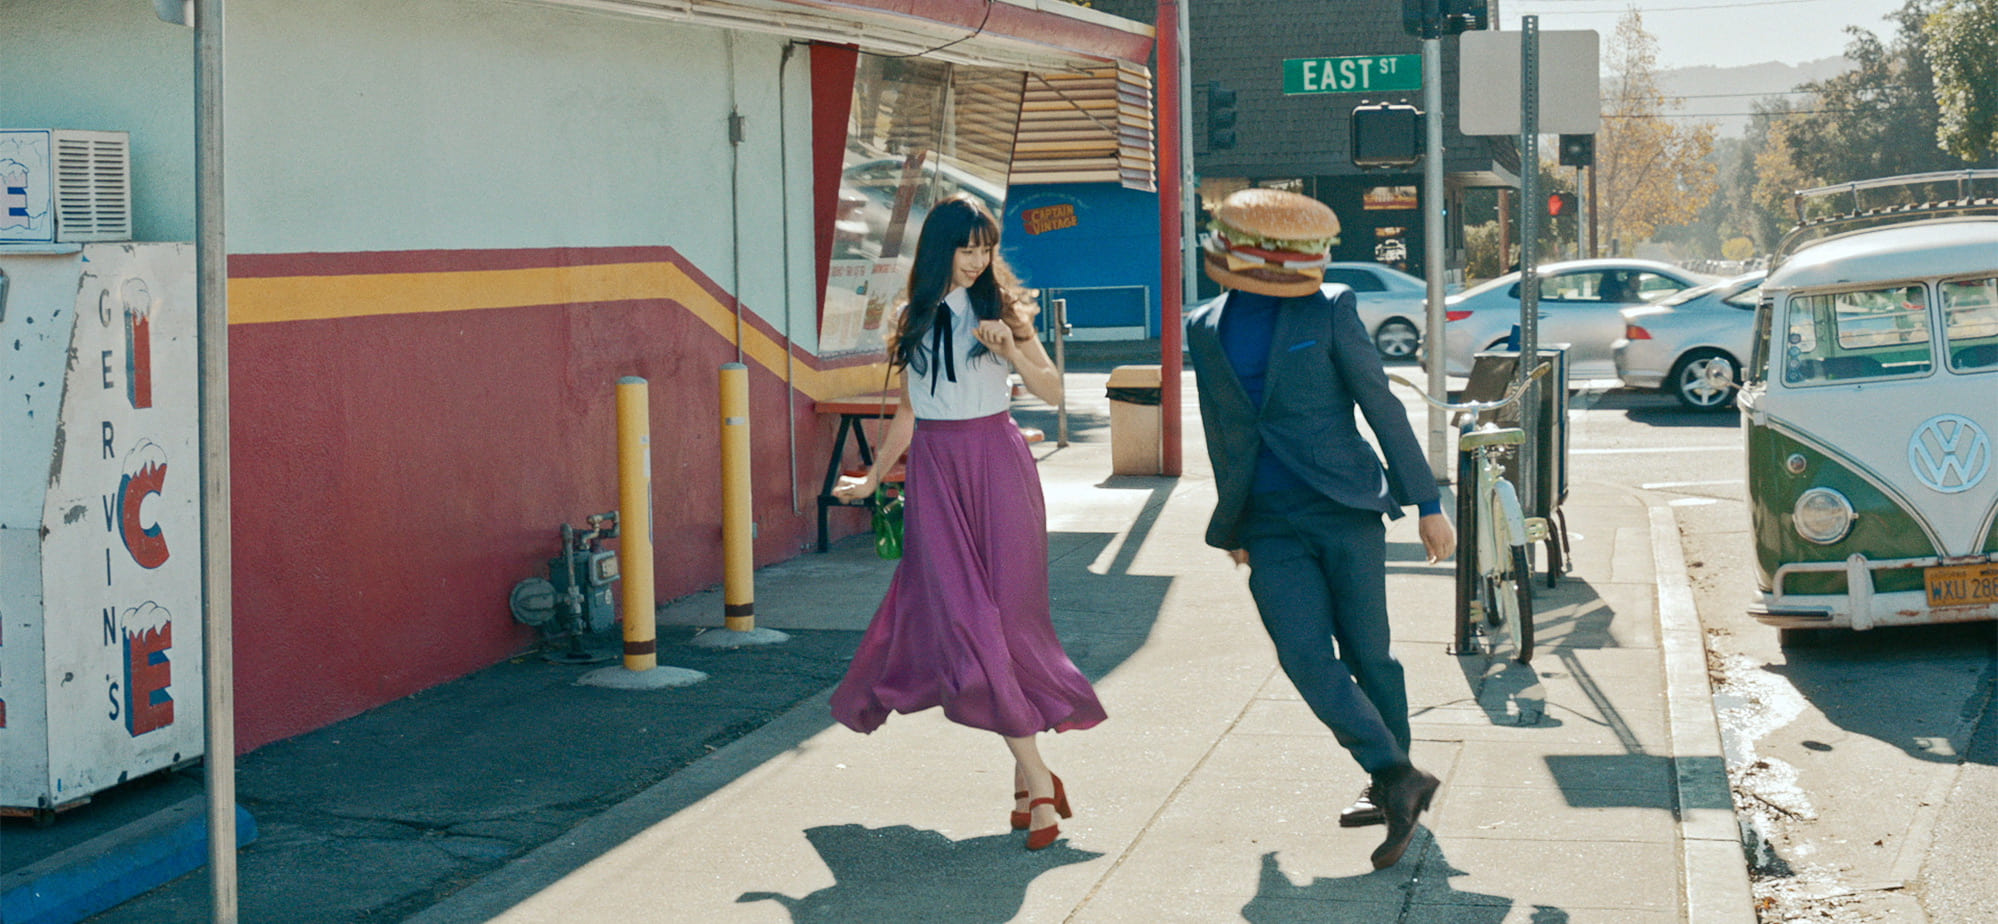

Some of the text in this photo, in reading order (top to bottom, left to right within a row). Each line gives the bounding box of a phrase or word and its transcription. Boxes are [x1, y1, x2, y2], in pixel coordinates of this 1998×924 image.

[1303, 57, 1397, 91] EAST ST
[1030, 204, 1074, 224] CAPTAIN
[1033, 216, 1078, 235] VINTAGE
[1908, 413, 1991, 494] VW
[99, 288, 120, 721] GERVIN'S
[116, 277, 174, 738] ICE
[1931, 579, 1967, 601] WXU
